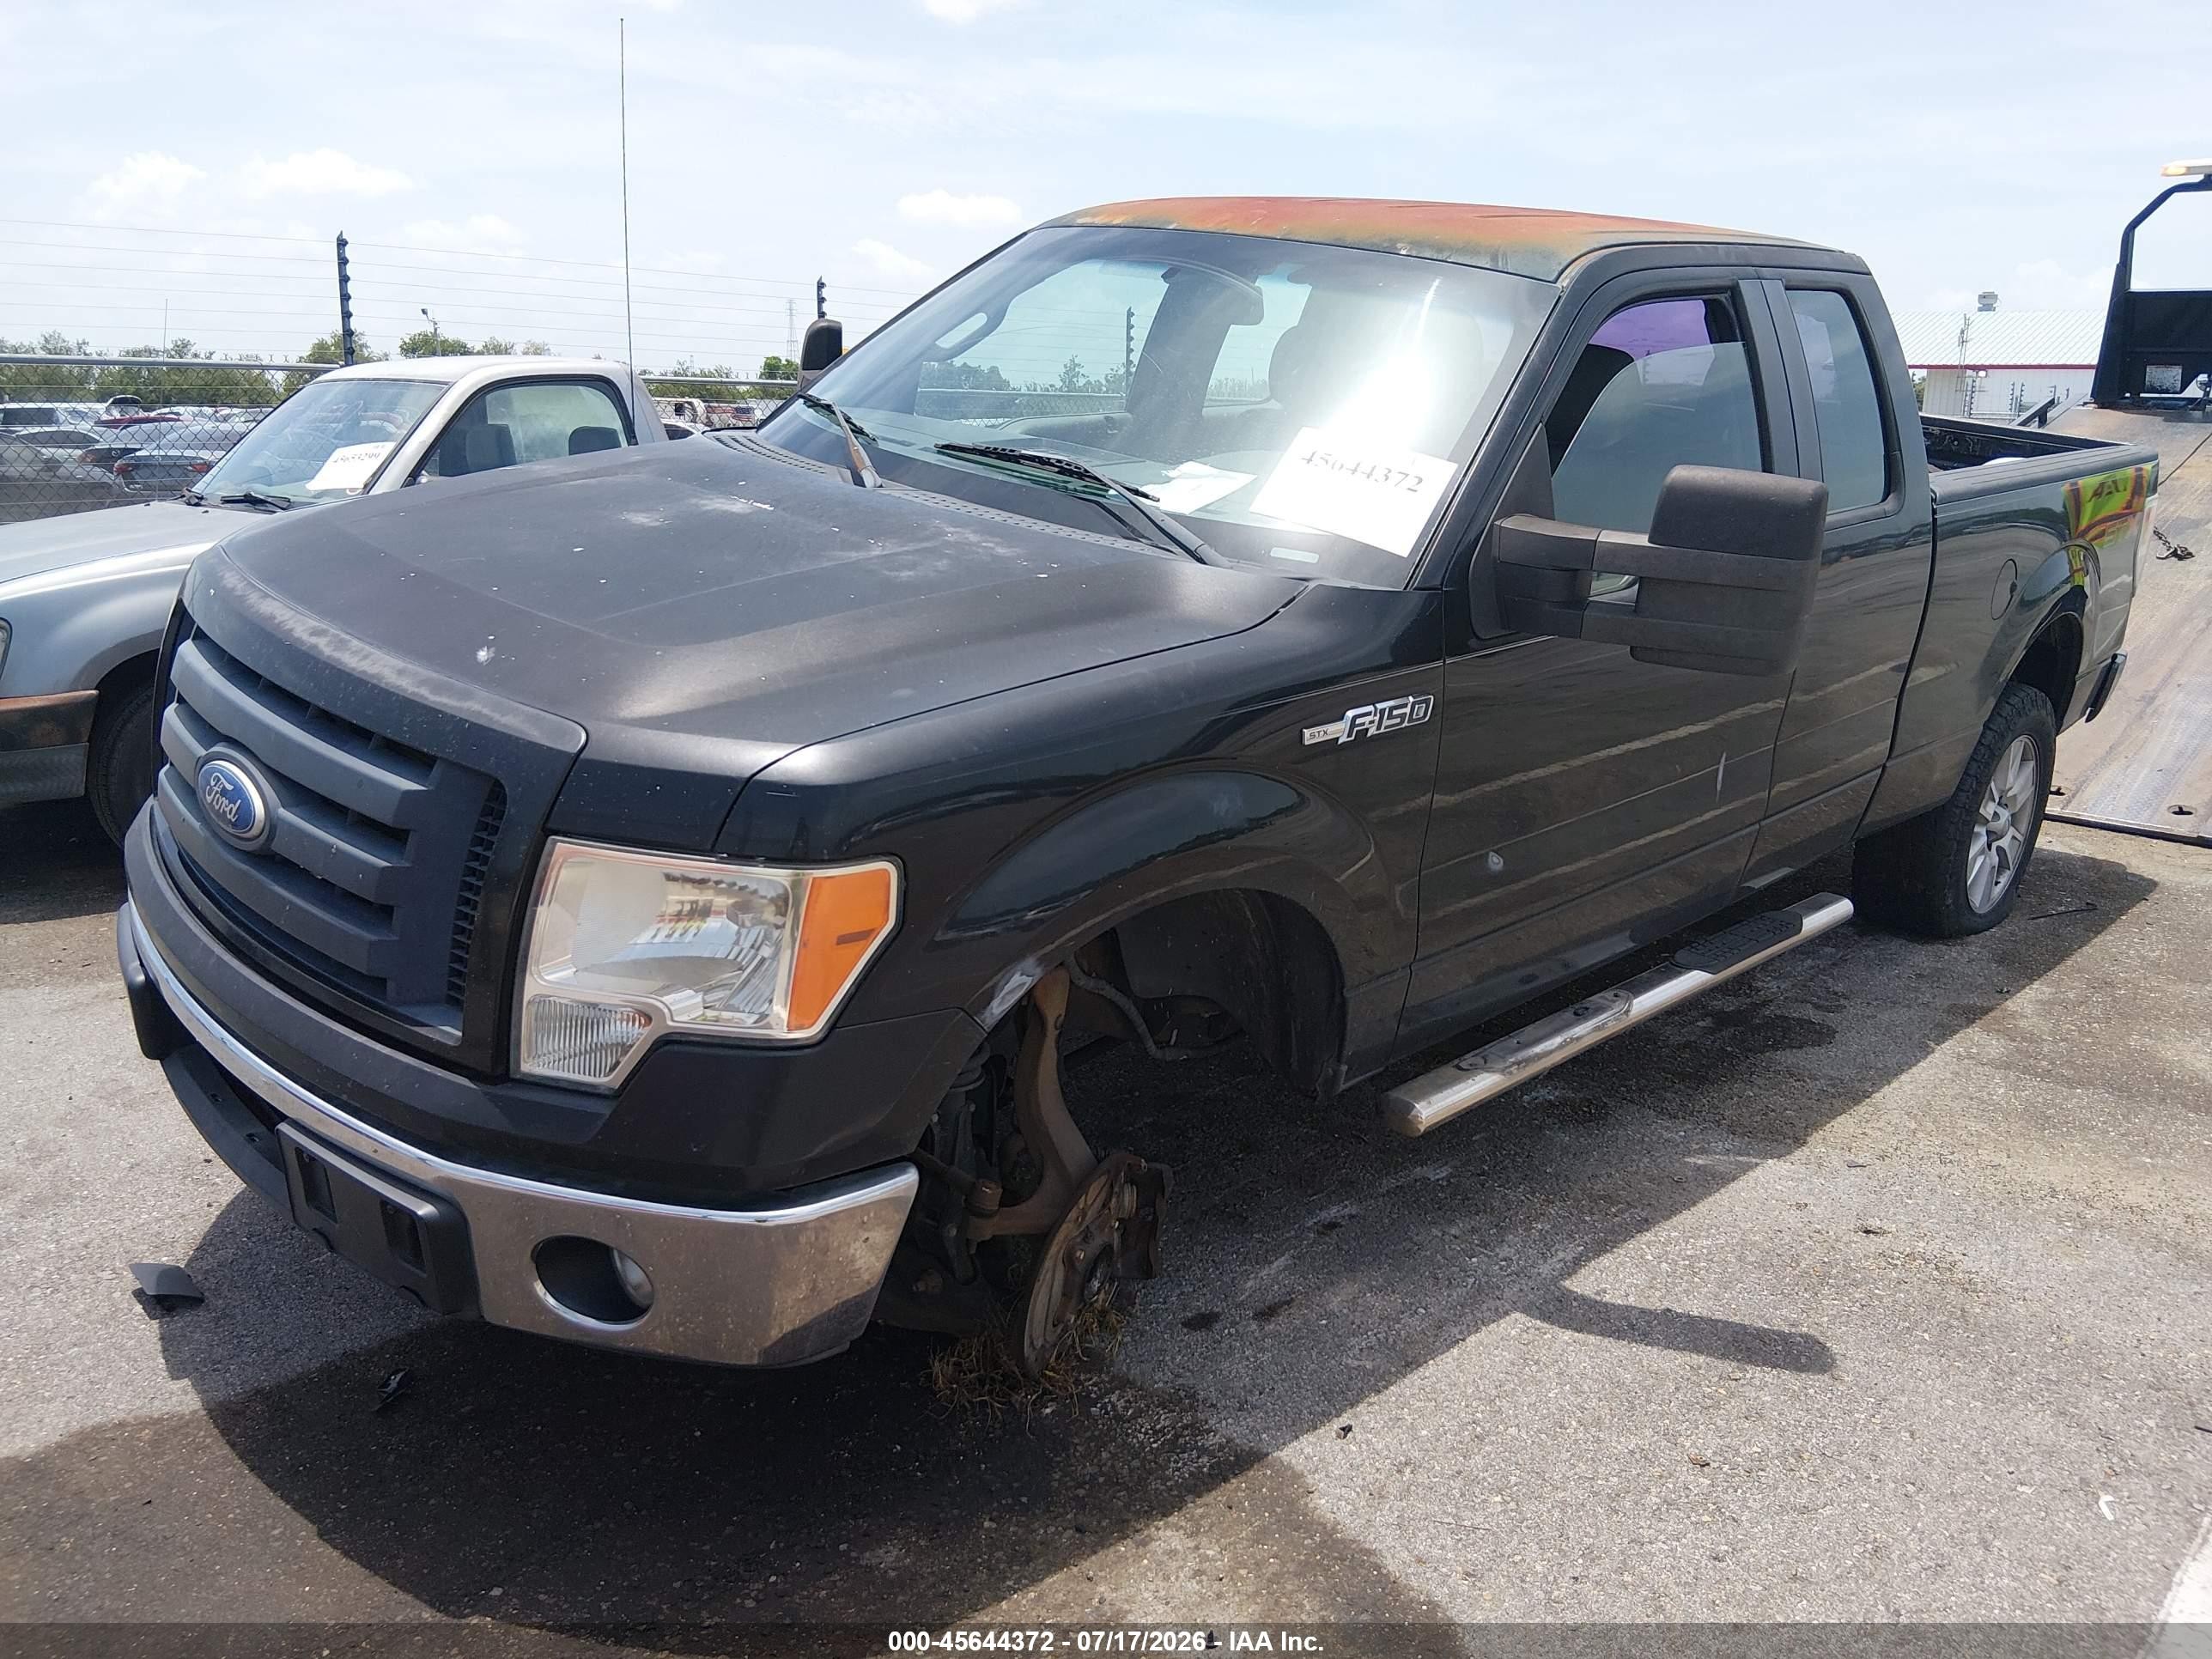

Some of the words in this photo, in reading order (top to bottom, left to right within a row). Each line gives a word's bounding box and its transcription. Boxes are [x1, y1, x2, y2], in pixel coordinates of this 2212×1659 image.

[1309, 727, 1329, 740] STX
[1339, 695, 1434, 744] F-150
[206, 773, 241, 822] Ford
